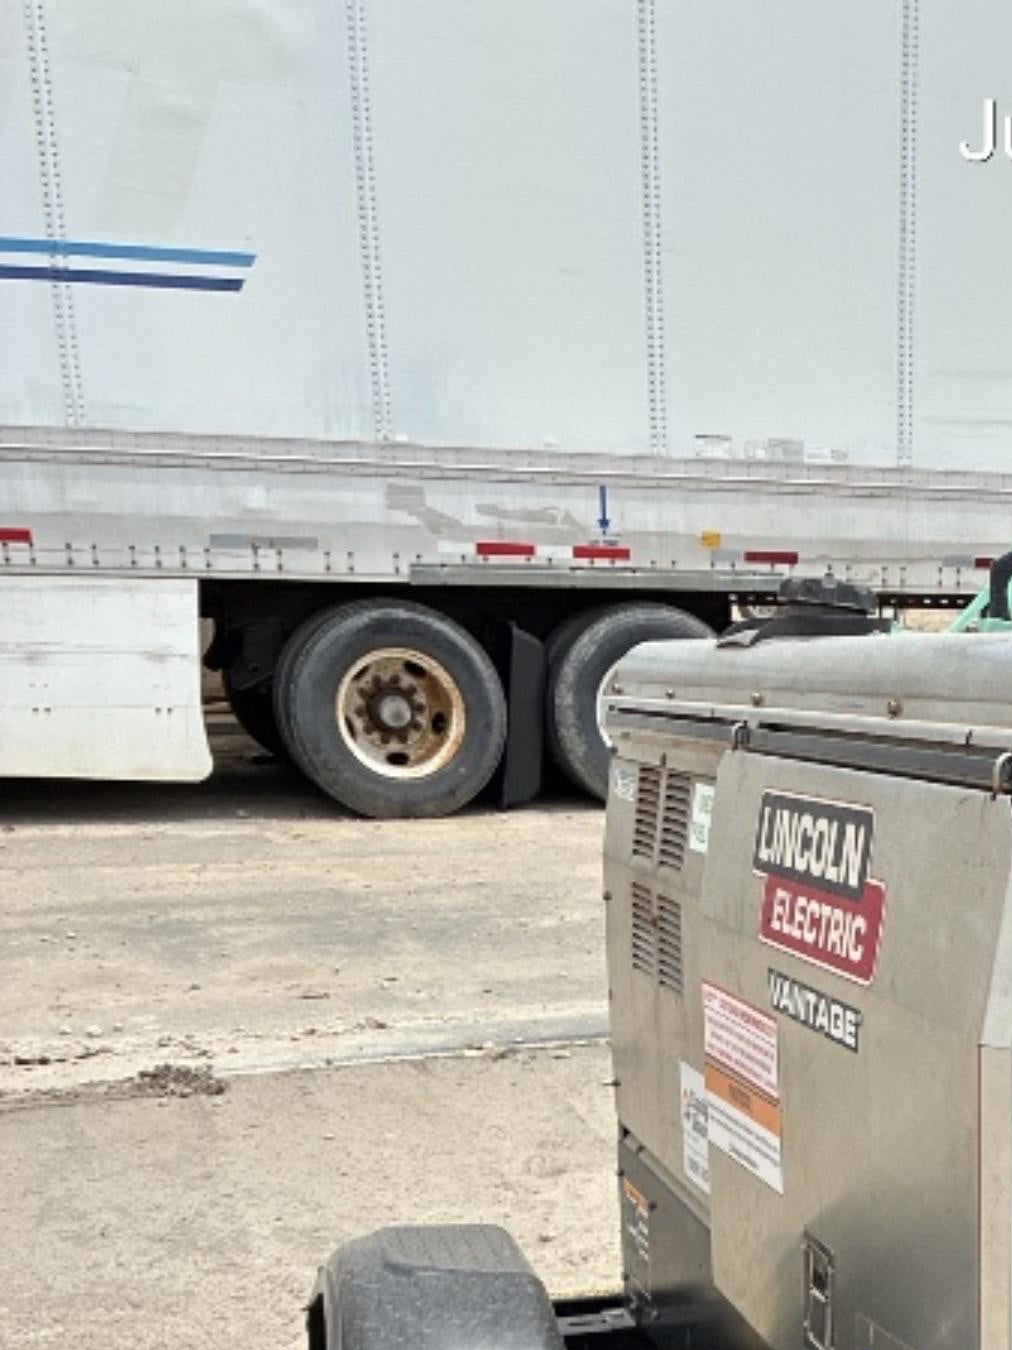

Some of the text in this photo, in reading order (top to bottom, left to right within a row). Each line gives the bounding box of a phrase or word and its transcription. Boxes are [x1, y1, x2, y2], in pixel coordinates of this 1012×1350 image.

[758, 806, 866, 889] LINCOLN
[770, 887, 867, 962] ELECTRIC
[770, 974, 857, 1048] VANTAGE
